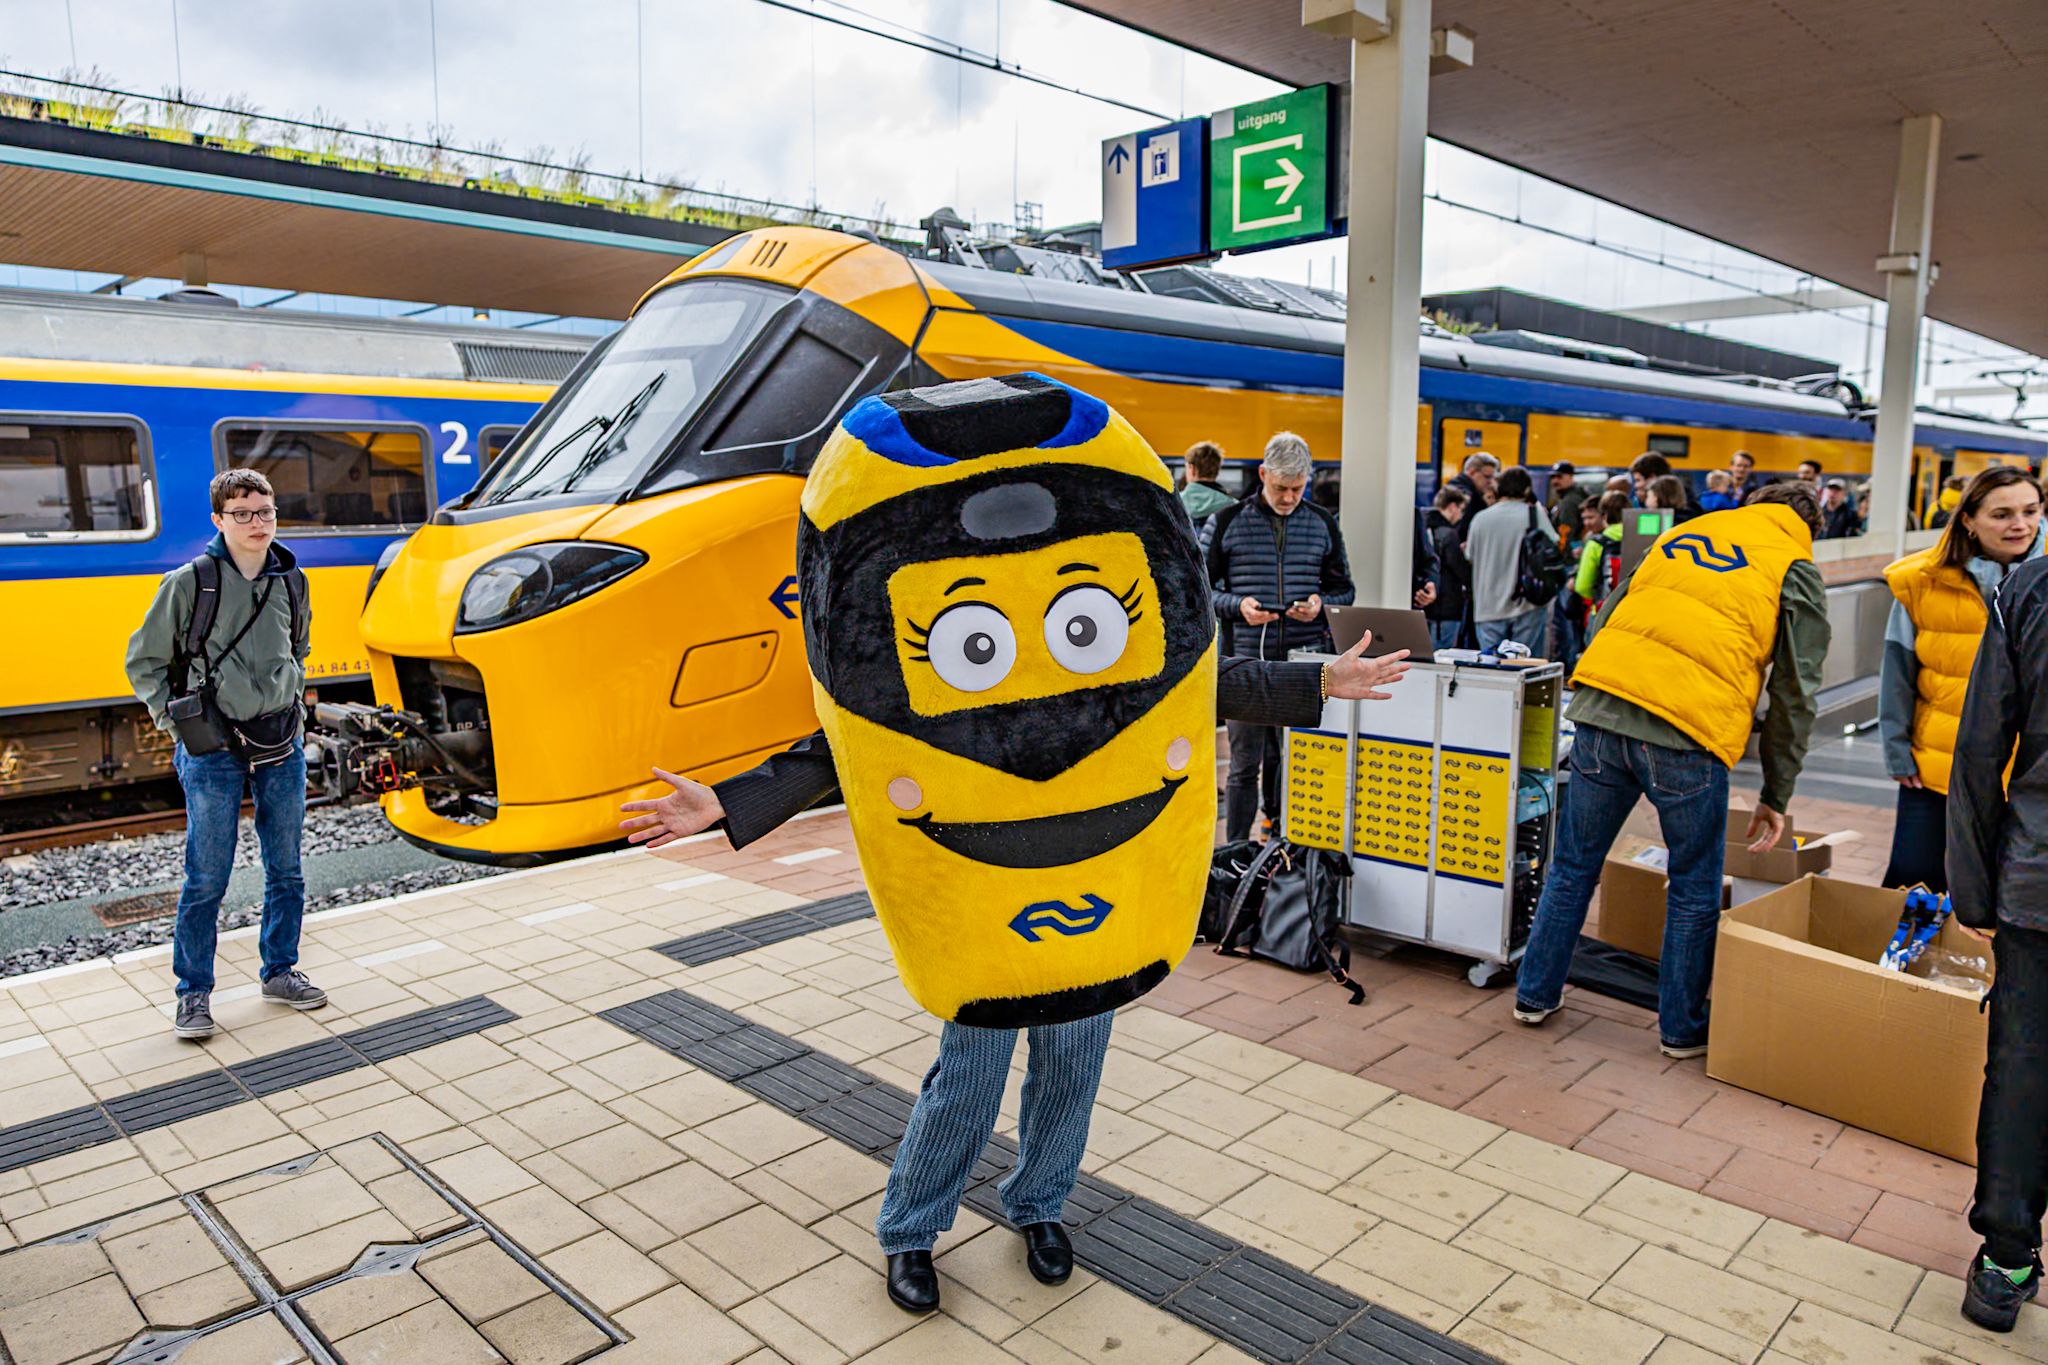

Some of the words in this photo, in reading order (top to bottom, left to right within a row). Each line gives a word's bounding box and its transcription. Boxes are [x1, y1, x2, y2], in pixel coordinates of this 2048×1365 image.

[1238, 109, 1287, 130] uitgang
[440, 420, 472, 464] 2
[307, 664, 325, 674] 94
[331, 661, 348, 673] 84
